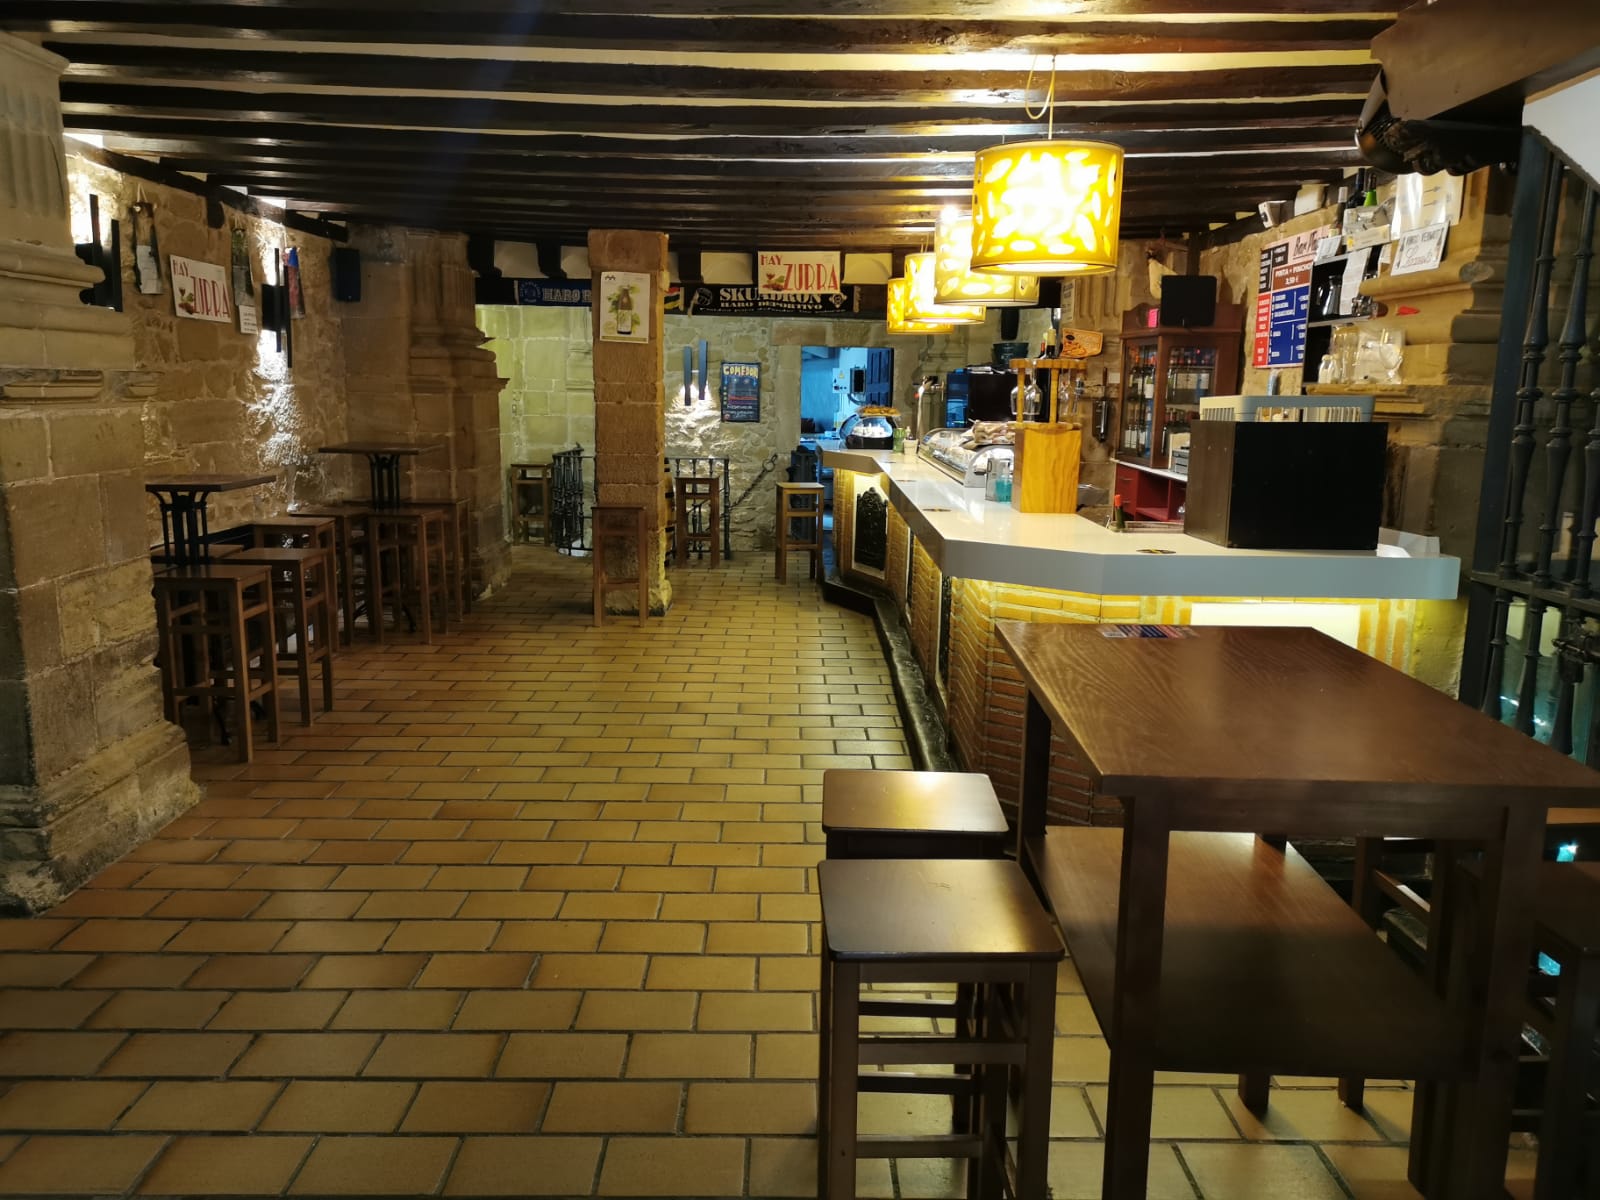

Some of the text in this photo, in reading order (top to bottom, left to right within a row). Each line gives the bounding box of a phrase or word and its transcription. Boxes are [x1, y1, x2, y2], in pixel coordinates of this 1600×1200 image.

[173, 259, 190, 279] HAY
[760, 254, 783, 266] HAY
[783, 263, 839, 291] ZURRA
[190, 276, 230, 318] ZURRA
[542, 287, 580, 303] HARO
[758, 301, 823, 310] DEPORTIVO
